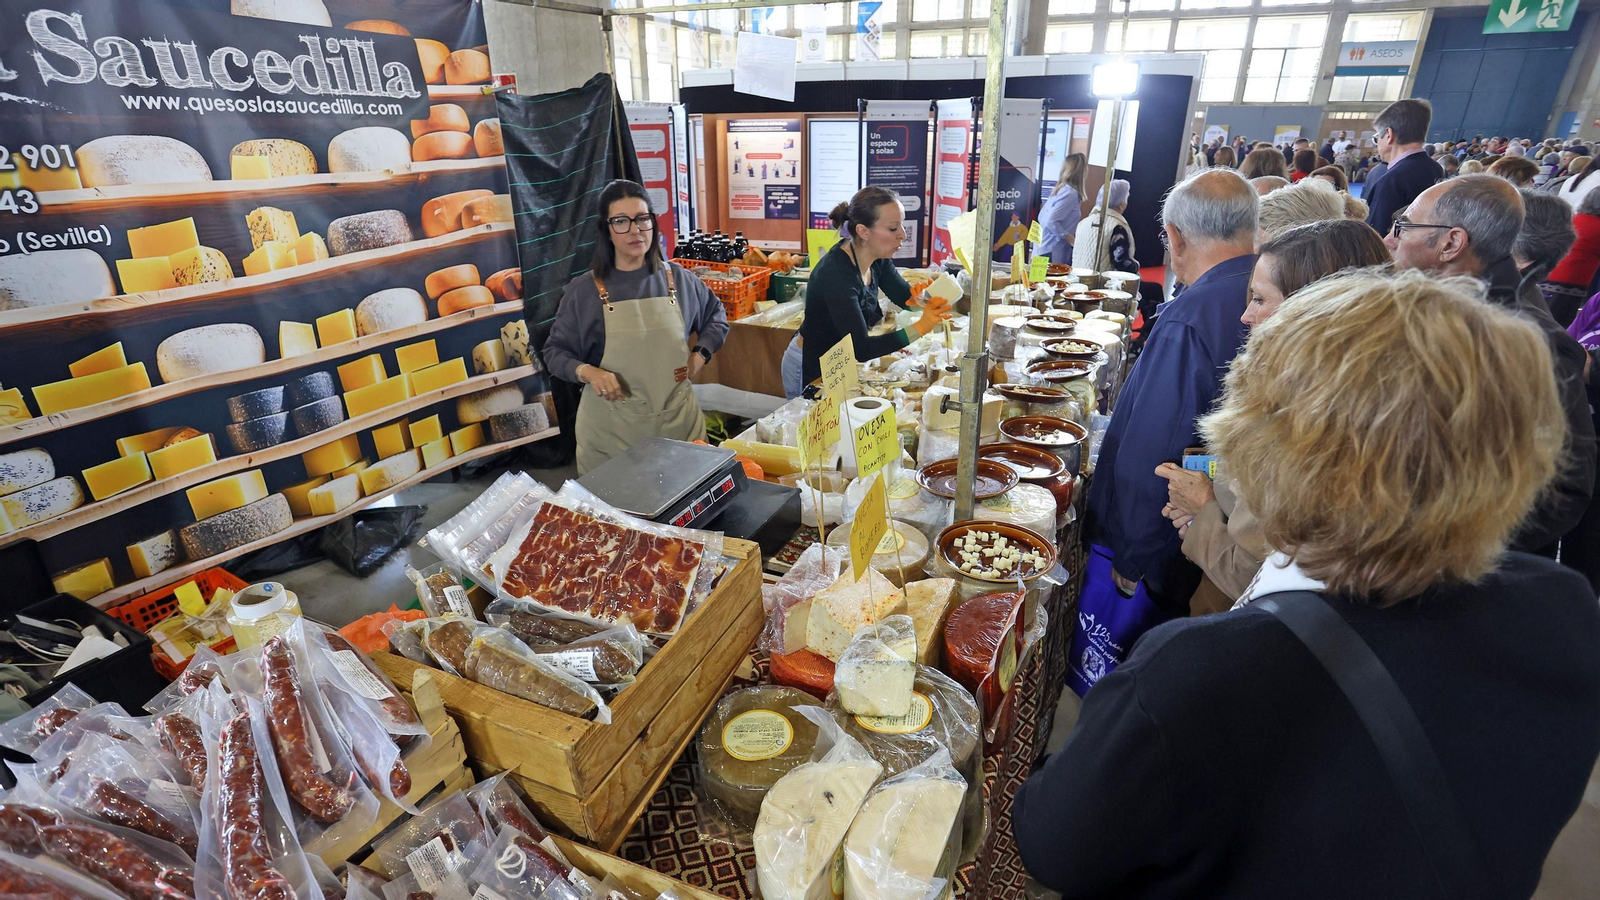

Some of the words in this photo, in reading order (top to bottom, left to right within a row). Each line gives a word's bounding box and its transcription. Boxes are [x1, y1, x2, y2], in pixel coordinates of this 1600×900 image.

[25, 9, 421, 98] Saucedilla
[1369, 49, 1403, 58] ASEOS
[121, 94, 403, 116] www.quesoslasaucedilla.com
[870, 140, 898, 149] espacio
[21, 144, 76, 169] 901
[995, 200, 1016, 210] olas
[16, 224, 112, 255] (Sevilla)
[858, 414, 886, 441] OVEJA
[858, 442, 873, 458] CON
[1091, 623, 1111, 642] 125
